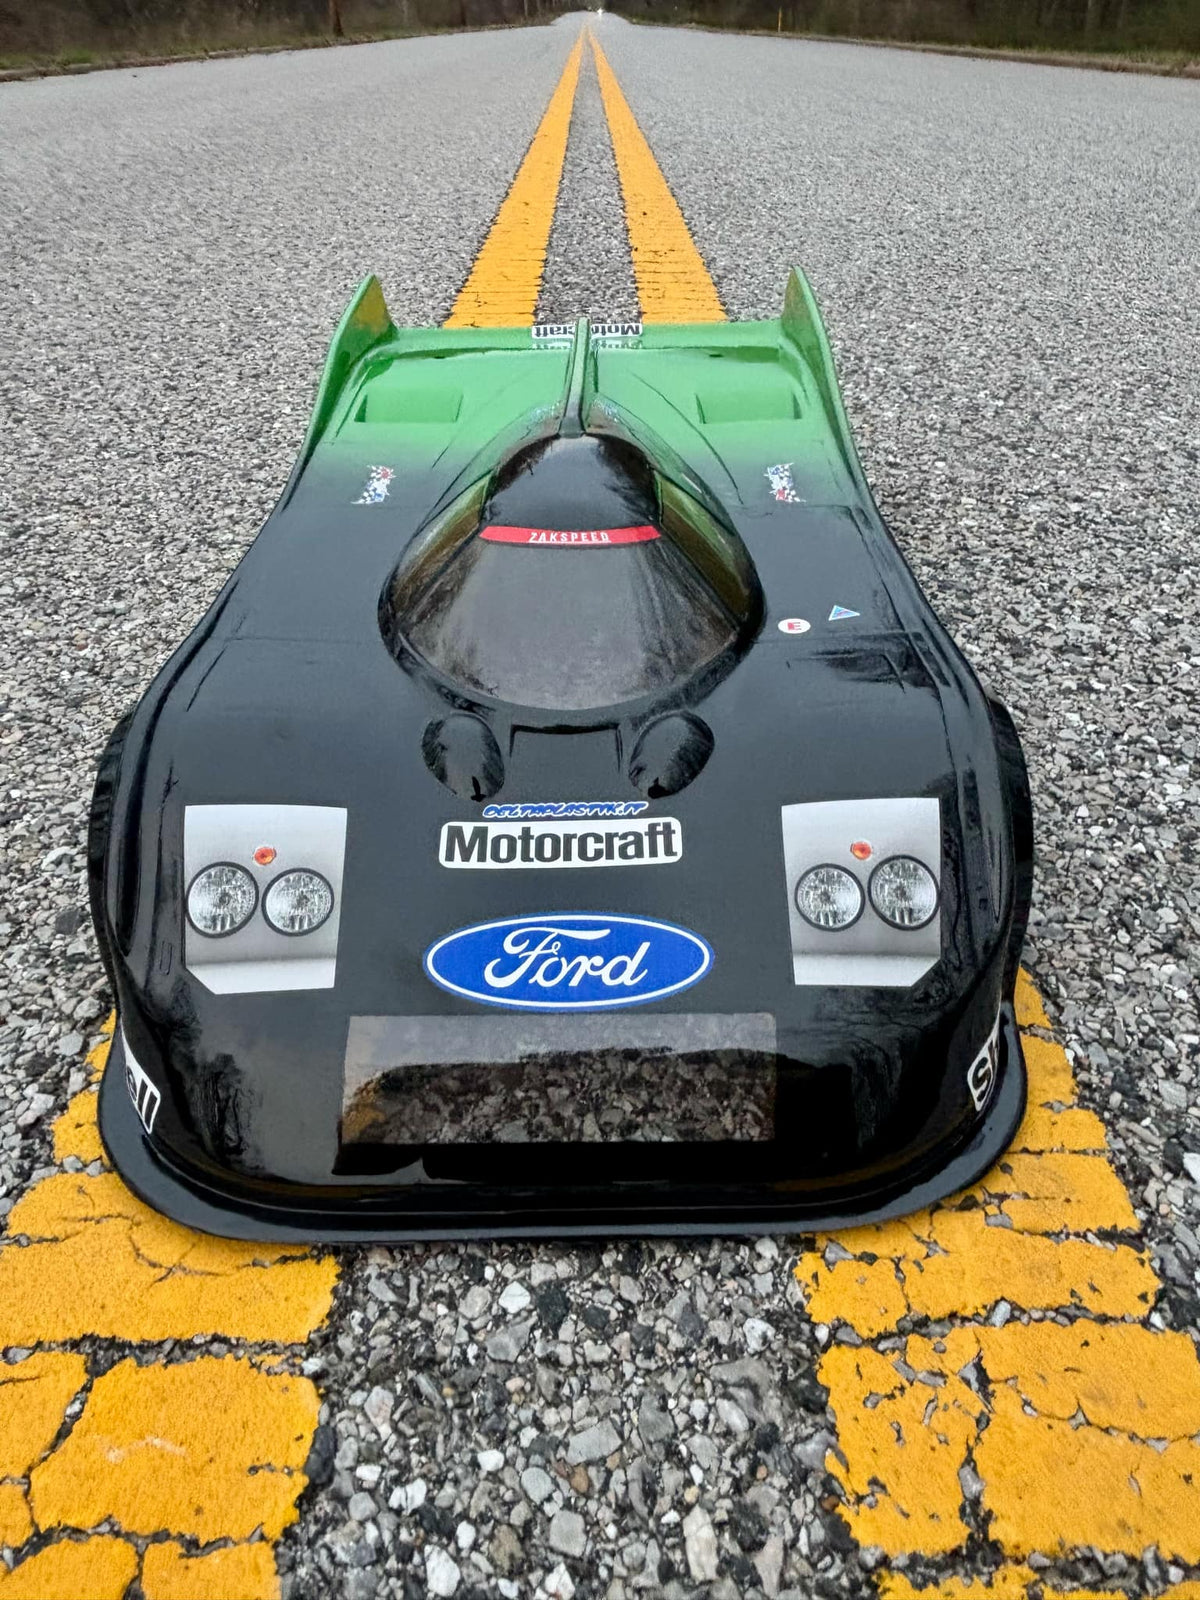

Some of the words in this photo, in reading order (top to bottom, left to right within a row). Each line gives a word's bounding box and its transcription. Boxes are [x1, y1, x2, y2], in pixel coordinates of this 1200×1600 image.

[535, 324, 640, 337] Motocraft
[529, 532, 610, 543] ZAKSPEED
[444, 821, 678, 863] Motorcraft
[484, 926, 651, 988] Ford
[126, 1065, 158, 1129] ell
